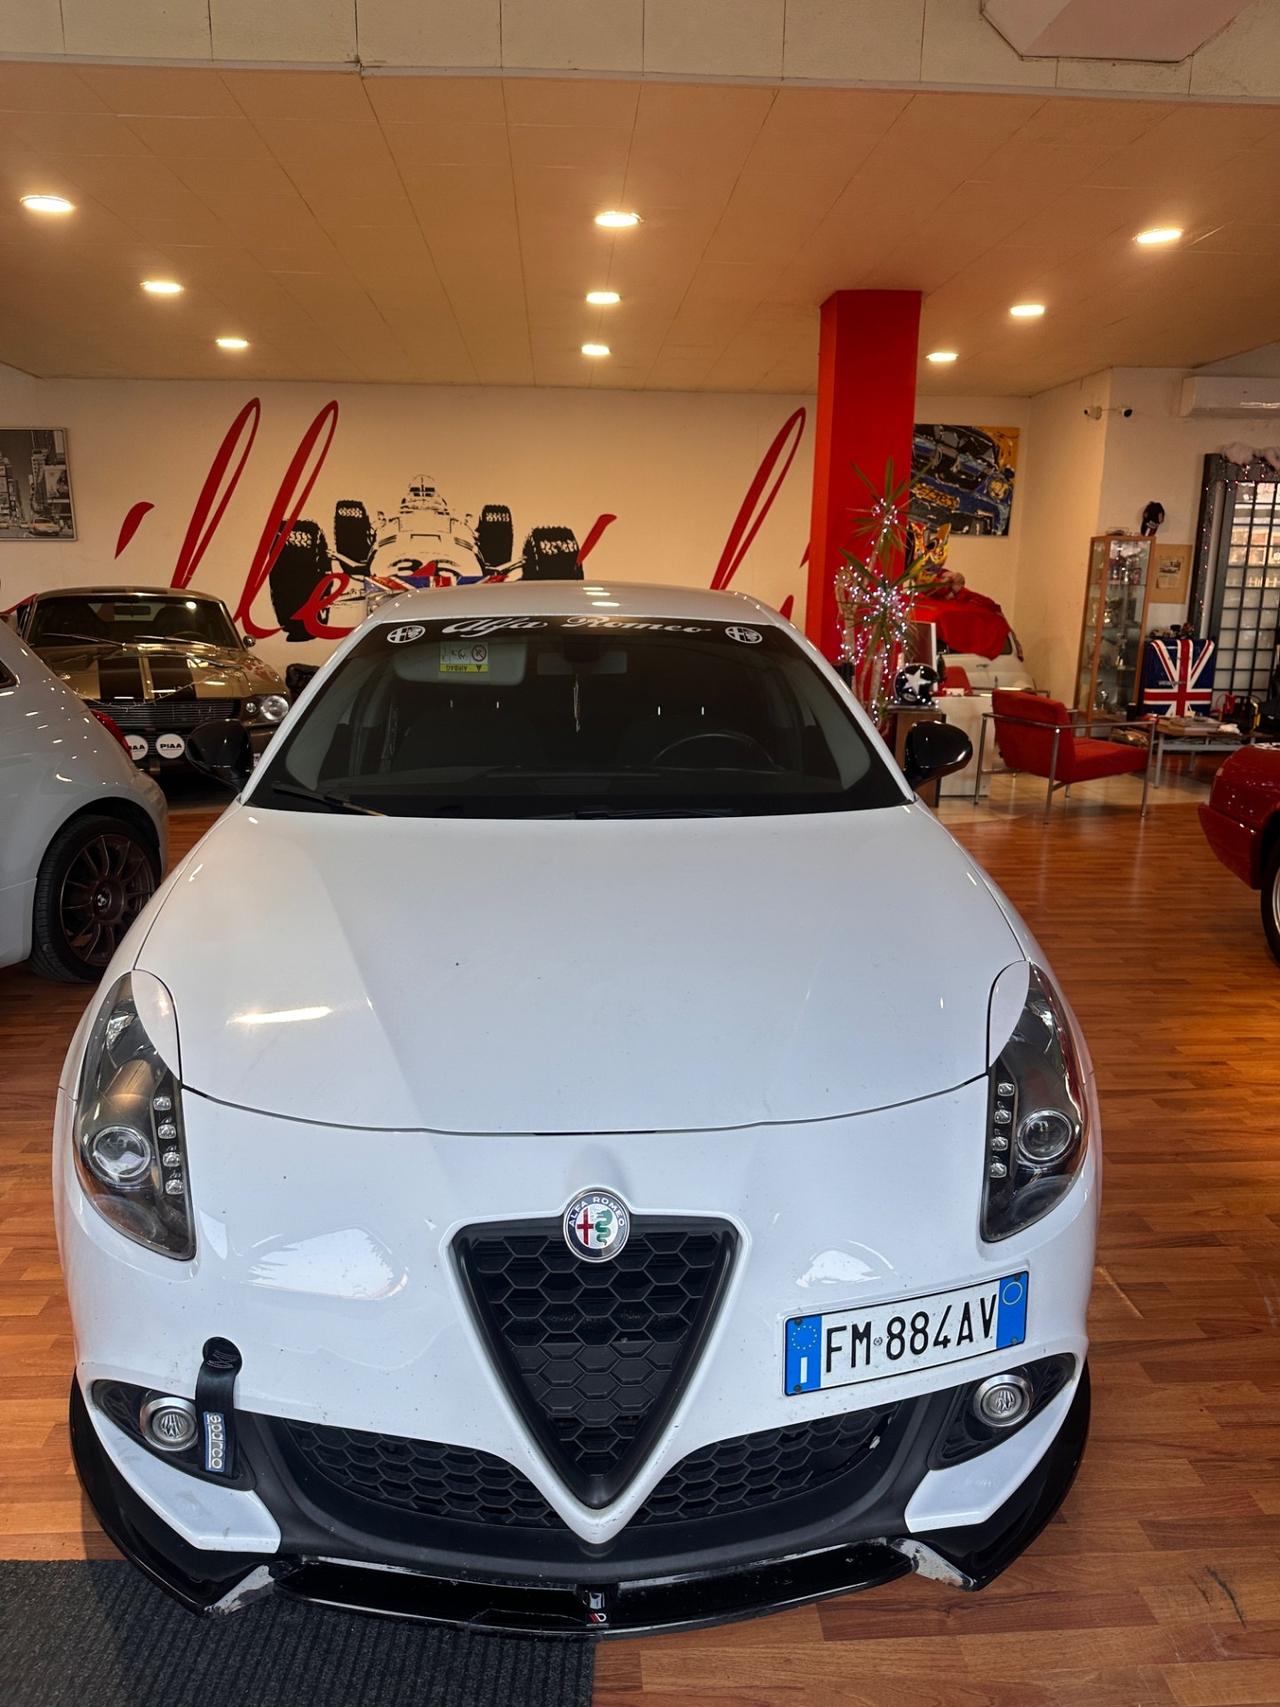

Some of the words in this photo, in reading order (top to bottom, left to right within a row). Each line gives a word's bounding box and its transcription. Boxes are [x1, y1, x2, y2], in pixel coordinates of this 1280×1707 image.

[442, 617, 548, 638] Alfa
[561, 615, 712, 633] Romeo
[568, 1200, 589, 1228] ALFA
[592, 1196, 625, 1227] ROMEO
[206, 1413, 224, 1470] sparco
